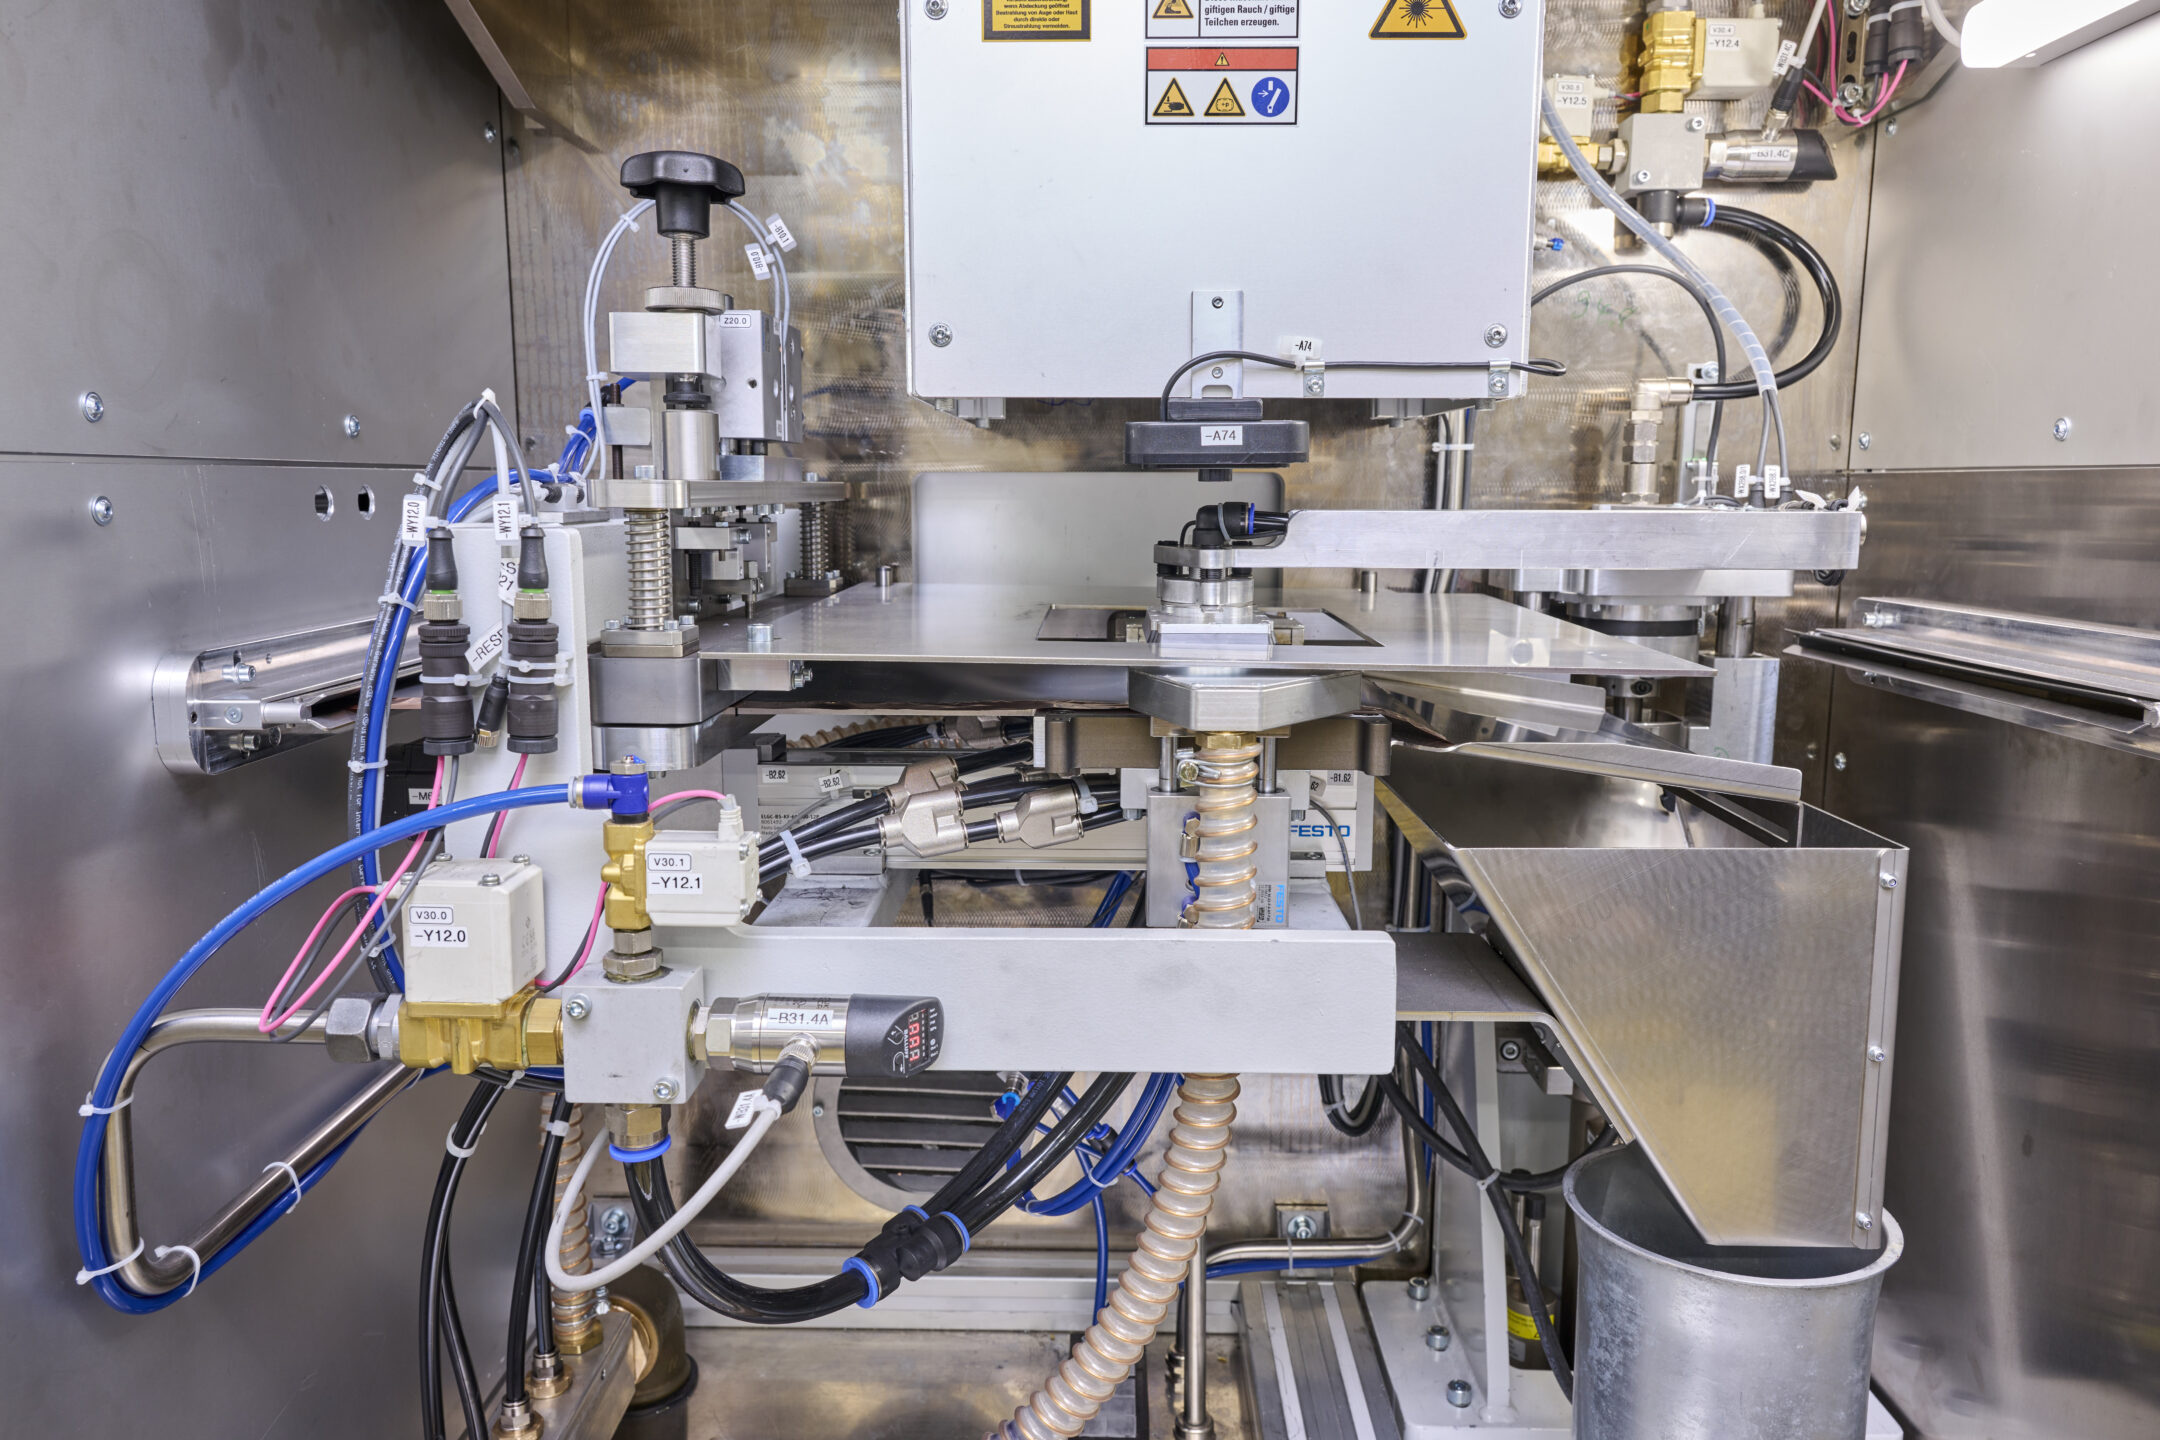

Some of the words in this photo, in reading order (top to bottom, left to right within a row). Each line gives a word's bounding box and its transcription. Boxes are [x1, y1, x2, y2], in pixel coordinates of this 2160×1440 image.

[1204, 5, 1235, 15] giftigen
[1237, 5, 1263, 14] Rauch
[1269, 4, 1295, 15] giftige
[1204, 17, 1239, 27] Teilchen
[1240, 19, 1280, 28] erzeugen.
[1709, 39, 1740, 48] -Y12.4
[1557, 96, 1588, 105] -Y12.5
[724, 317, 747, 325] Z20.0
[1295, 340, 1312, 351] -A74
[1205, 430, 1236, 441] -A74
[406, 501, 420, 539] -WY12.0
[497, 501, 511, 539] -WY12.1
[765, 769, 786, 780] -B2.62
[1330, 773, 1351, 783] -B1.62
[820, 776, 841, 789] -B2.62
[1290, 825, 1351, 838] FESTO
[654, 858, 685, 867] V30.1
[651, 877, 701, 889] -Y12.1
[1275, 884, 1285, 924] FESTO
[416, 911, 447, 920] V30.0
[414, 930, 466, 943] -Y12.0
[769, 1012, 829, 1025] -B31.4A
